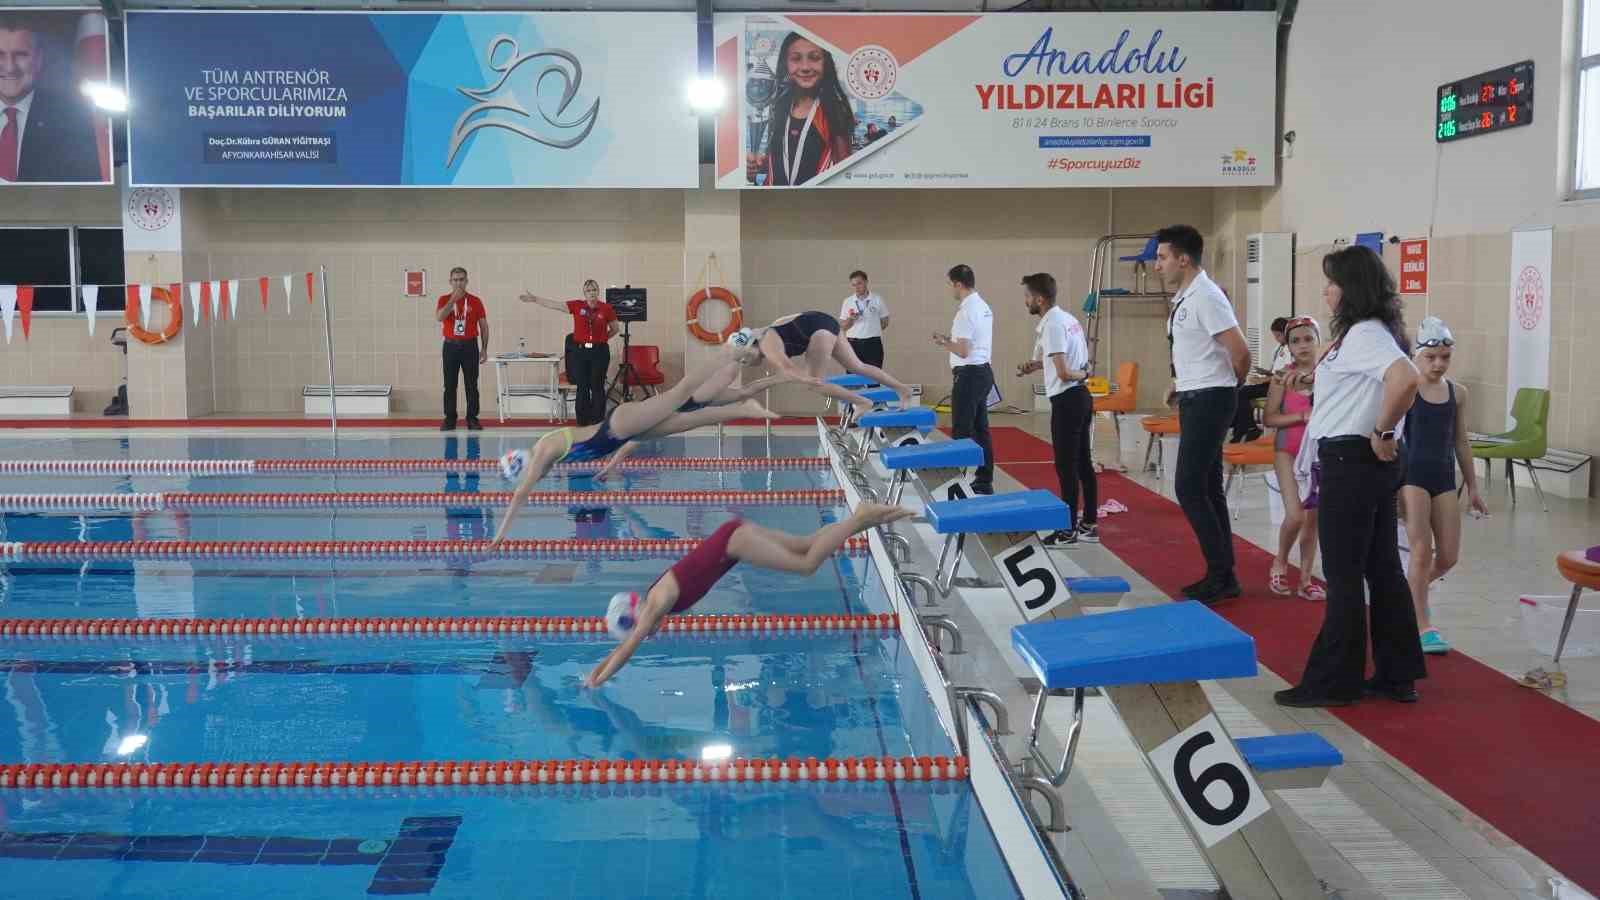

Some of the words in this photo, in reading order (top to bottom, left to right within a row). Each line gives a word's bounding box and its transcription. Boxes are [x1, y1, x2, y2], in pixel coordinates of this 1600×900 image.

[1002, 26, 1188, 77] Anadolu
[202, 68, 238, 84] TÜM
[242, 68, 330, 85] ANTRENÖR
[184, 86, 205, 101] VE
[207, 86, 348, 101] SPORCULARIMIZA
[975, 83, 1145, 110] YILDIZLARI
[1156, 77, 1214, 109] LİGİ
[188, 105, 266, 119] BAŞARILAR
[268, 103, 347, 117] DİLİYORUM
[1048, 157, 1142, 172] #SporcuyuzBiz
[1003, 544, 1057, 610] 5
[1173, 730, 1250, 826] 6
